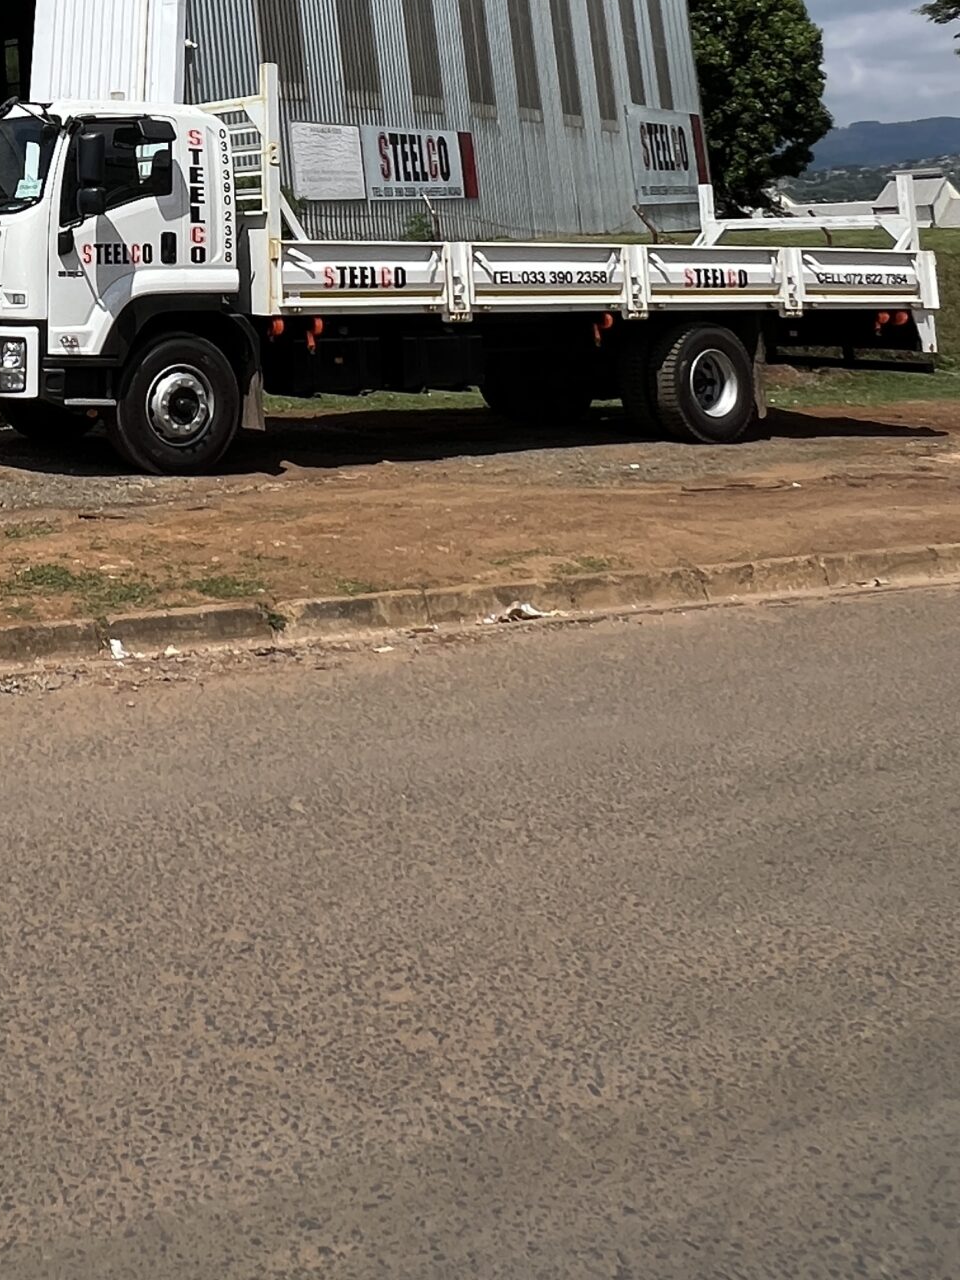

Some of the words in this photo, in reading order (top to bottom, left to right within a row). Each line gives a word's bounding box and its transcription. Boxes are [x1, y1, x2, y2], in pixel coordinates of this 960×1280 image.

[378, 131, 451, 182] STEELCO
[640, 122, 689, 171] STEELCO
[187, 129, 207, 264] STEELCO
[83, 243, 153, 265] STEELCO
[323, 266, 407, 289] STEELCO
[549, 270, 573, 284] 390
[576, 270, 608, 284] 2358
[684, 268, 749, 289] STEELCO
[865, 272, 883, 285] 622
